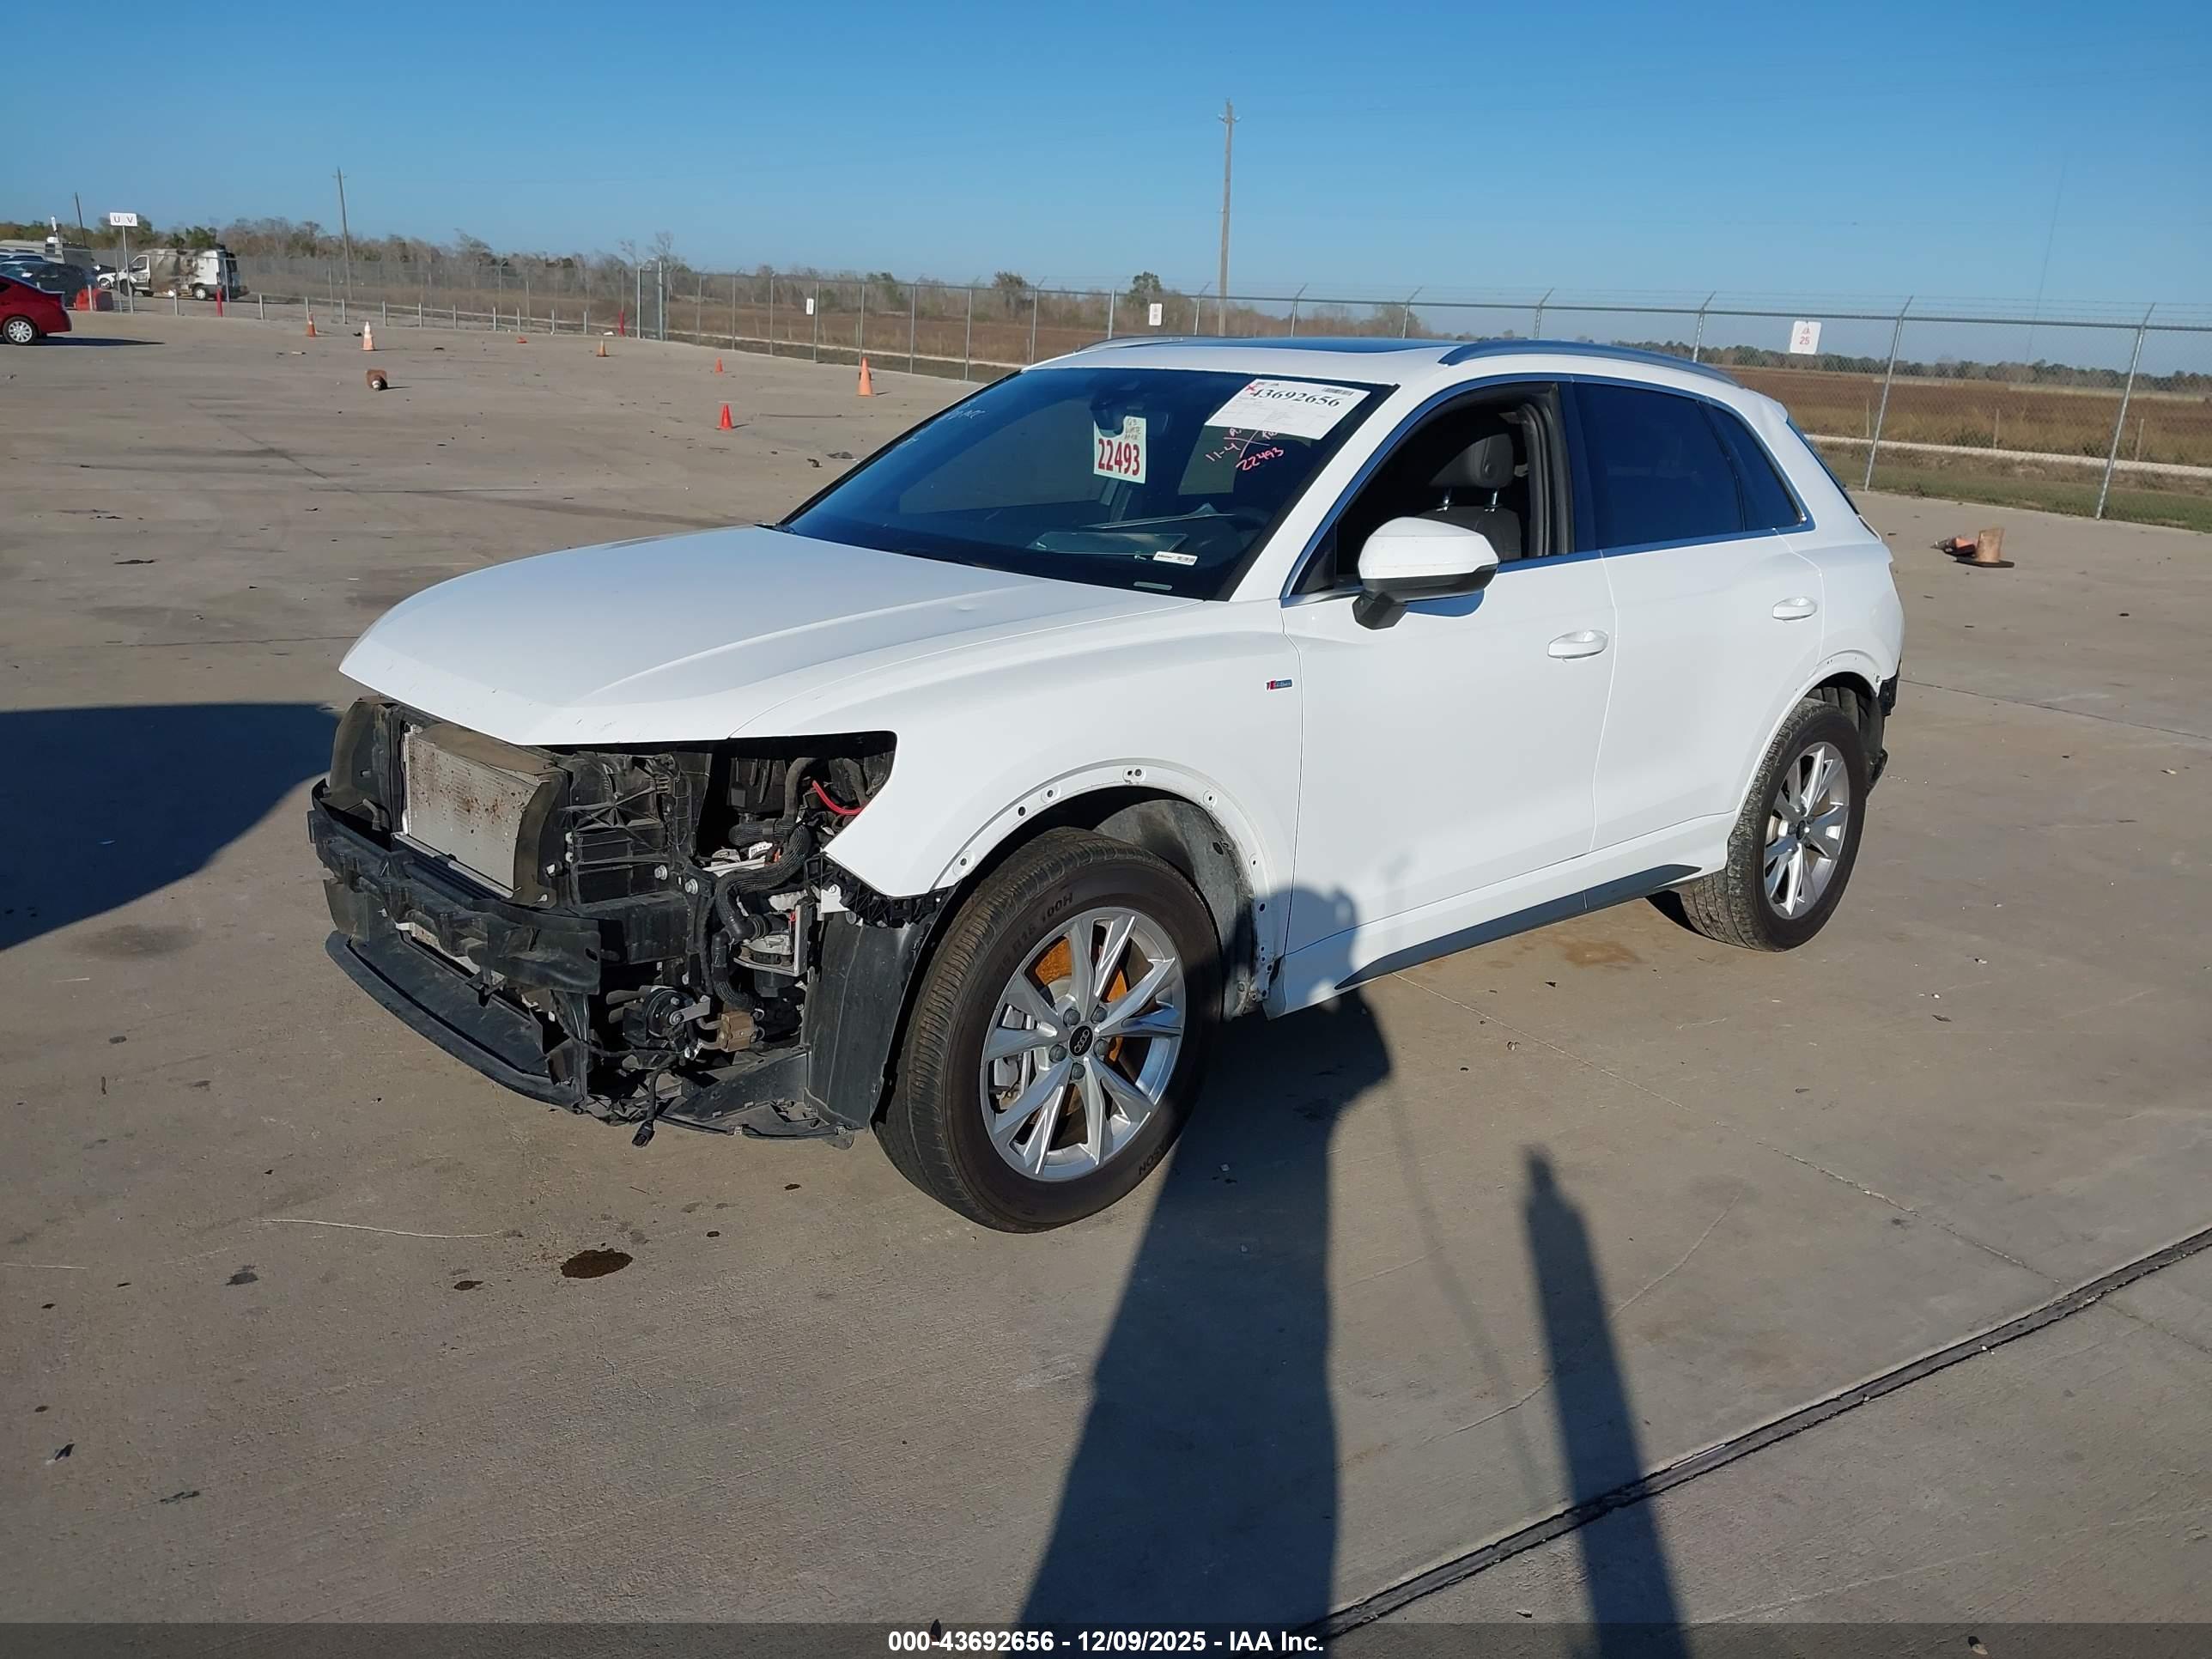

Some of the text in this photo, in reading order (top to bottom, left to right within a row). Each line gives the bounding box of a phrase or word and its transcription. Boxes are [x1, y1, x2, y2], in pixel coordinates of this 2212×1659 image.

[1799, 336, 1811, 345] 25
[1250, 388, 1342, 408] 43692656
[1098, 438, 1140, 477] 22493
[1235, 447, 1285, 471] 22493
